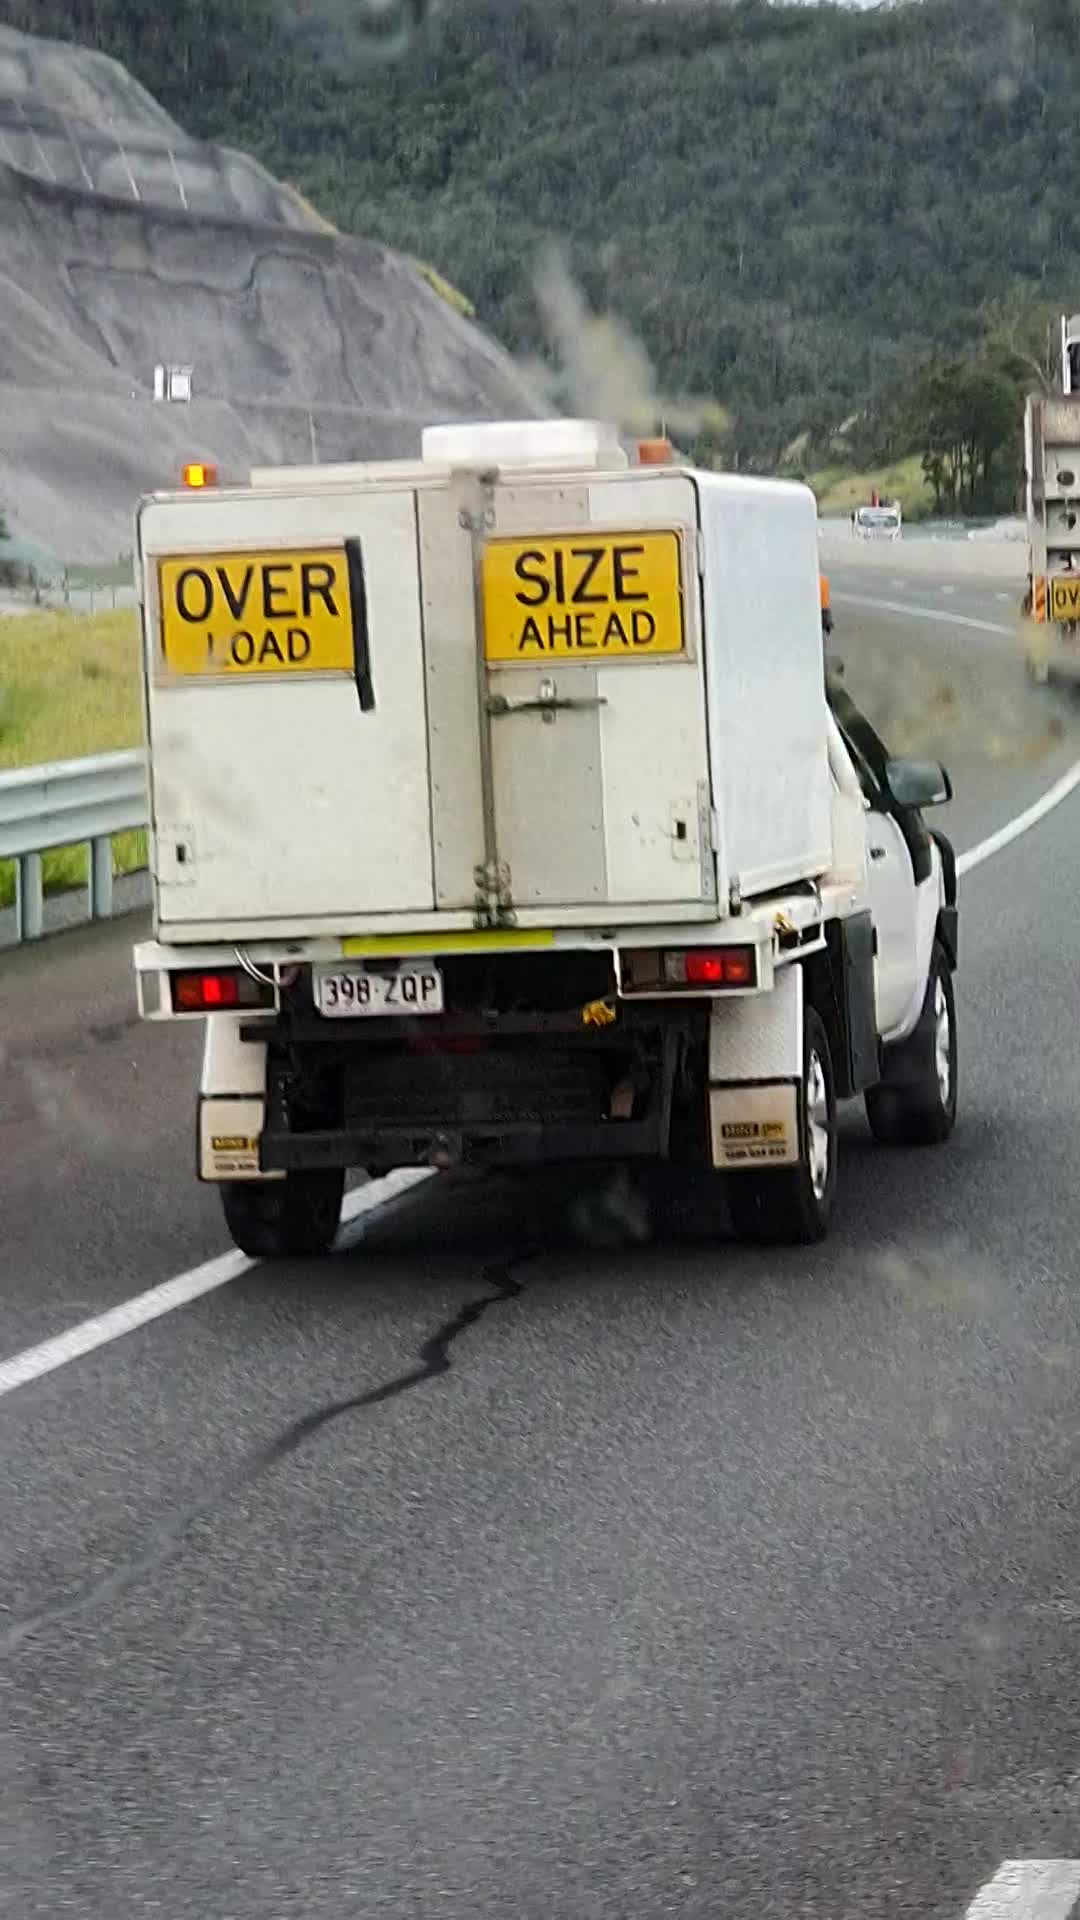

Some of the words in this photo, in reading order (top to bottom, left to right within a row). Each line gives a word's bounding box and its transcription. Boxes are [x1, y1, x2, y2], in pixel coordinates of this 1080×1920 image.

[176, 563, 339, 623] OVER
[514, 545, 649, 606] SIZE
[518, 610, 655, 651] AHEAD
